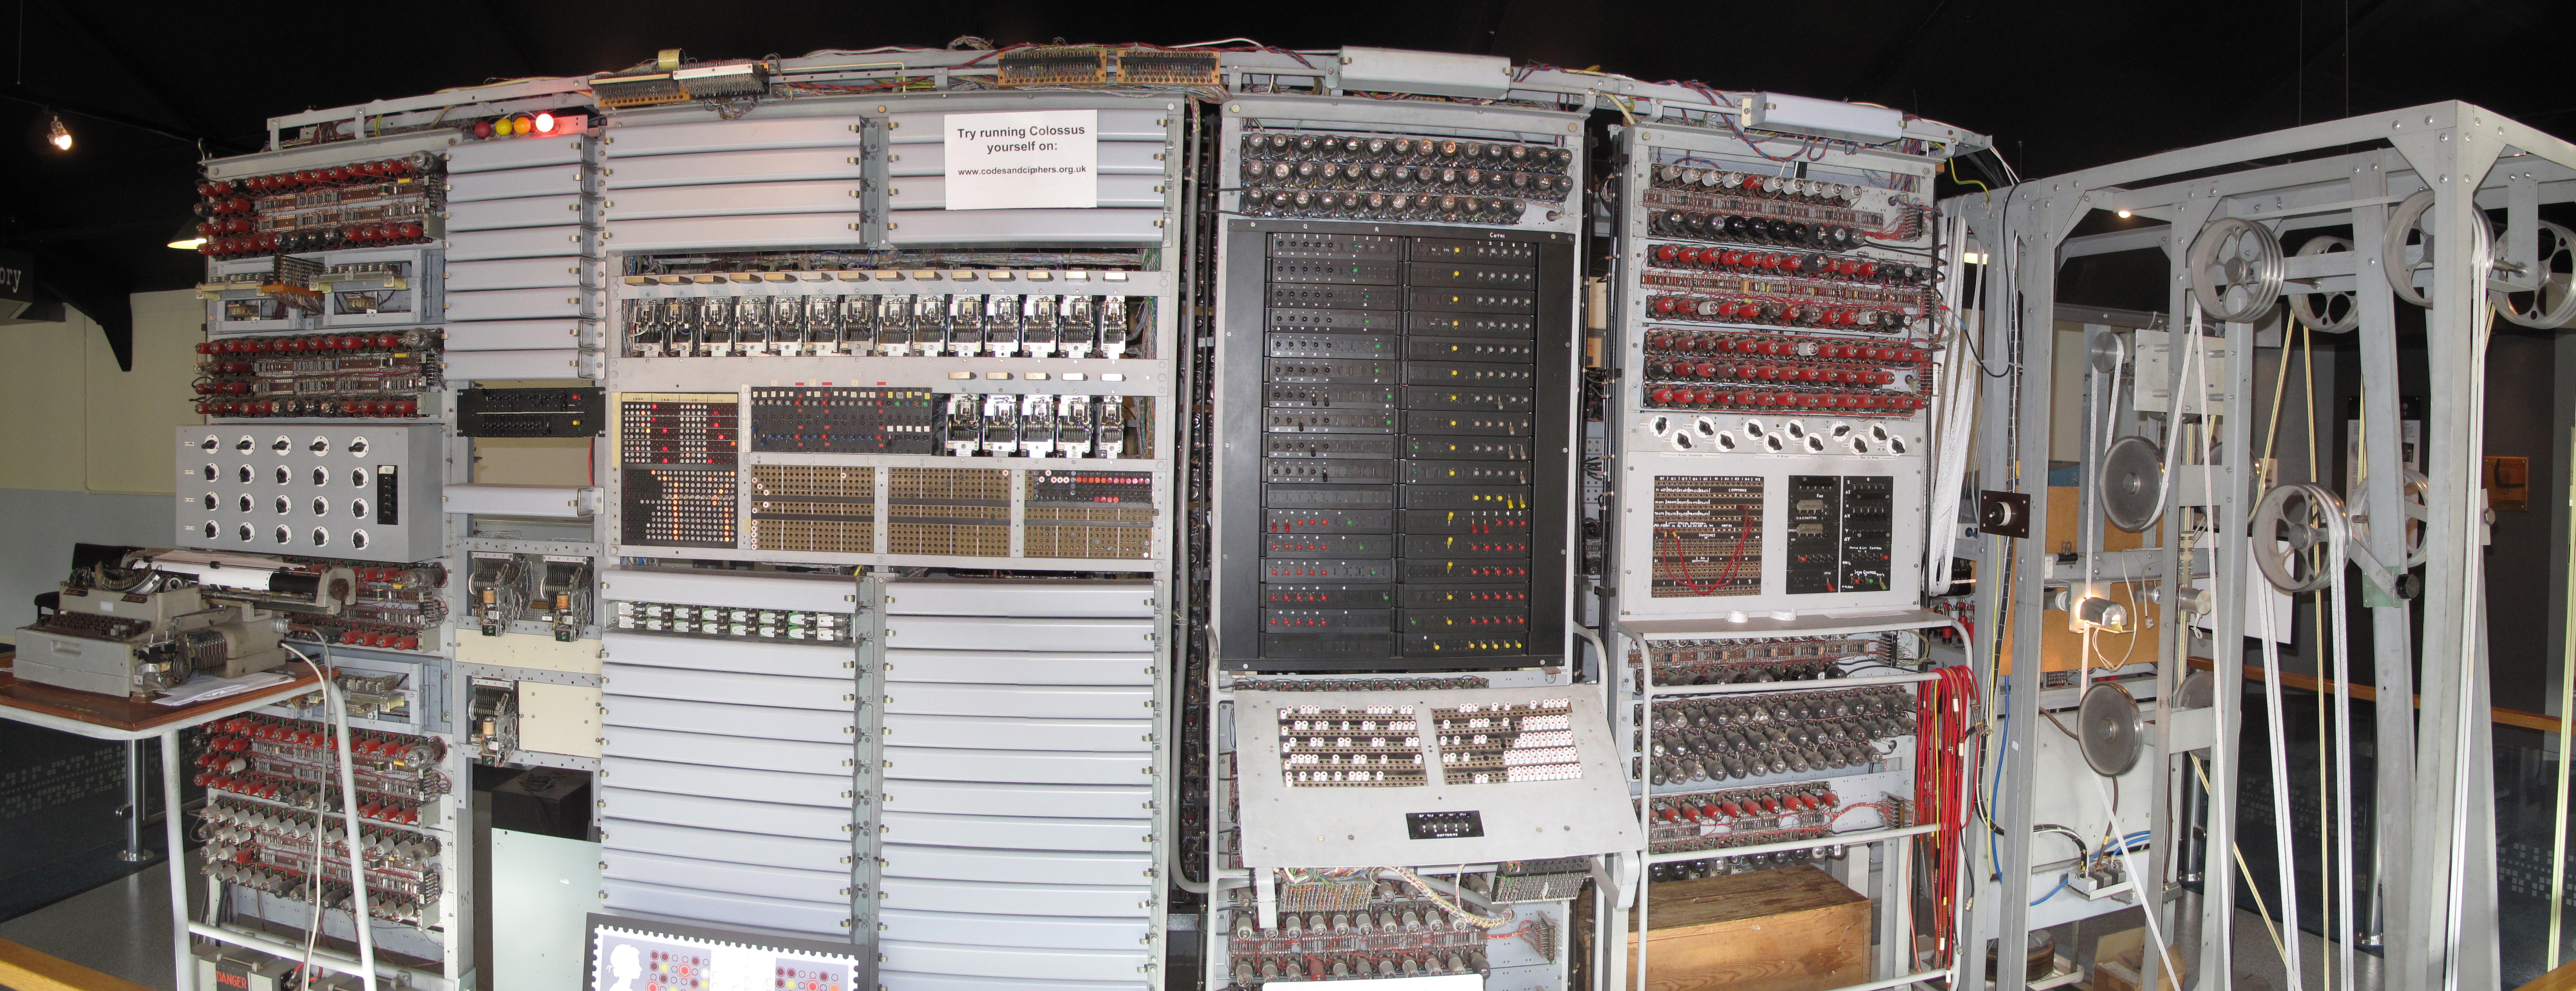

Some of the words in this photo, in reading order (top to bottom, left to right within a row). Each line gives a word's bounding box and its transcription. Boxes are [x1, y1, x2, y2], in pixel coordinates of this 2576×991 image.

[957, 129, 976, 140] Try
[980, 127, 1026, 139] running
[1030, 126, 1085, 136] Colossus
[987, 141, 1036, 155] yourself
[958, 166, 1086, 175] www.codesandciphers.org.uk
[217, 971, 247, 989] DANGER
